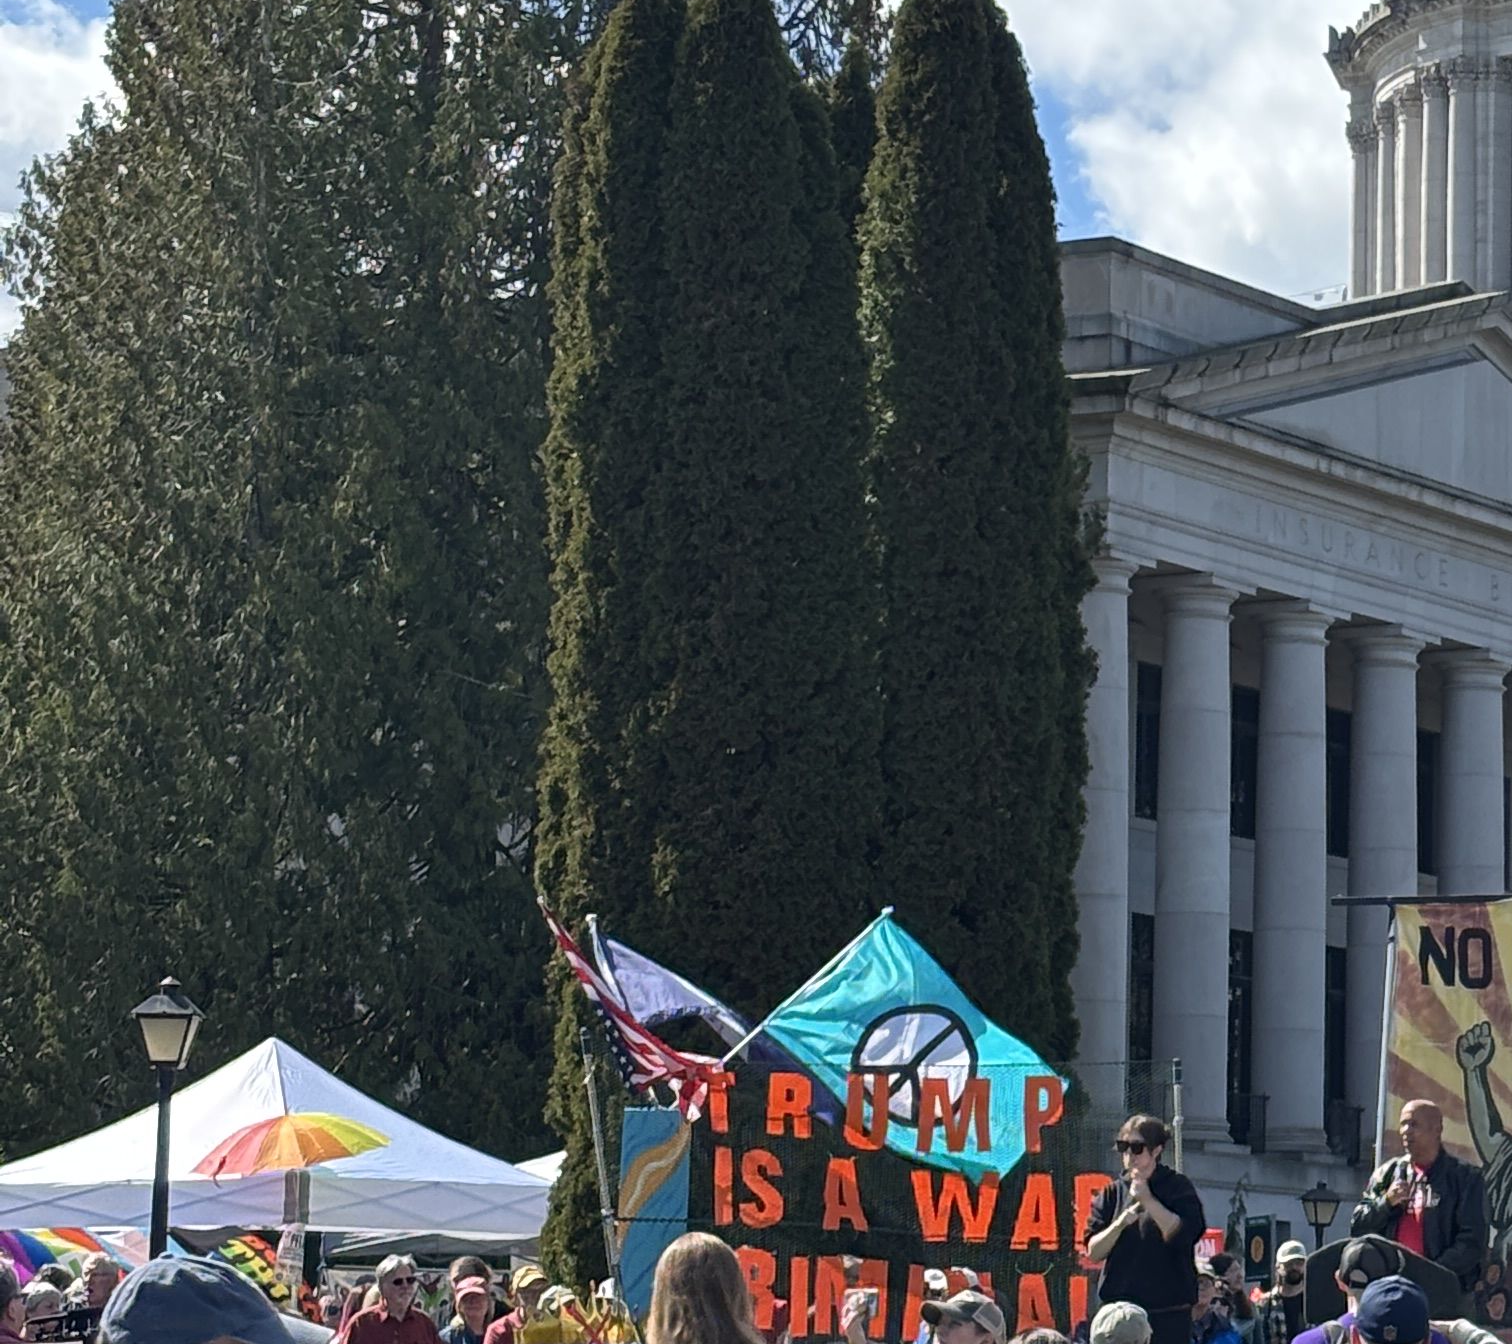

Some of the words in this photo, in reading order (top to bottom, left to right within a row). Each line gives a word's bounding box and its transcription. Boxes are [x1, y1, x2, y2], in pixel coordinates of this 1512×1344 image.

[1255, 505, 1450, 589] INSURANCE
[1418, 924, 1493, 990] NO
[702, 1070, 1066, 1154] TRUMP
[713, 1145, 784, 1229] IS
[821, 1156, 869, 1233] A
